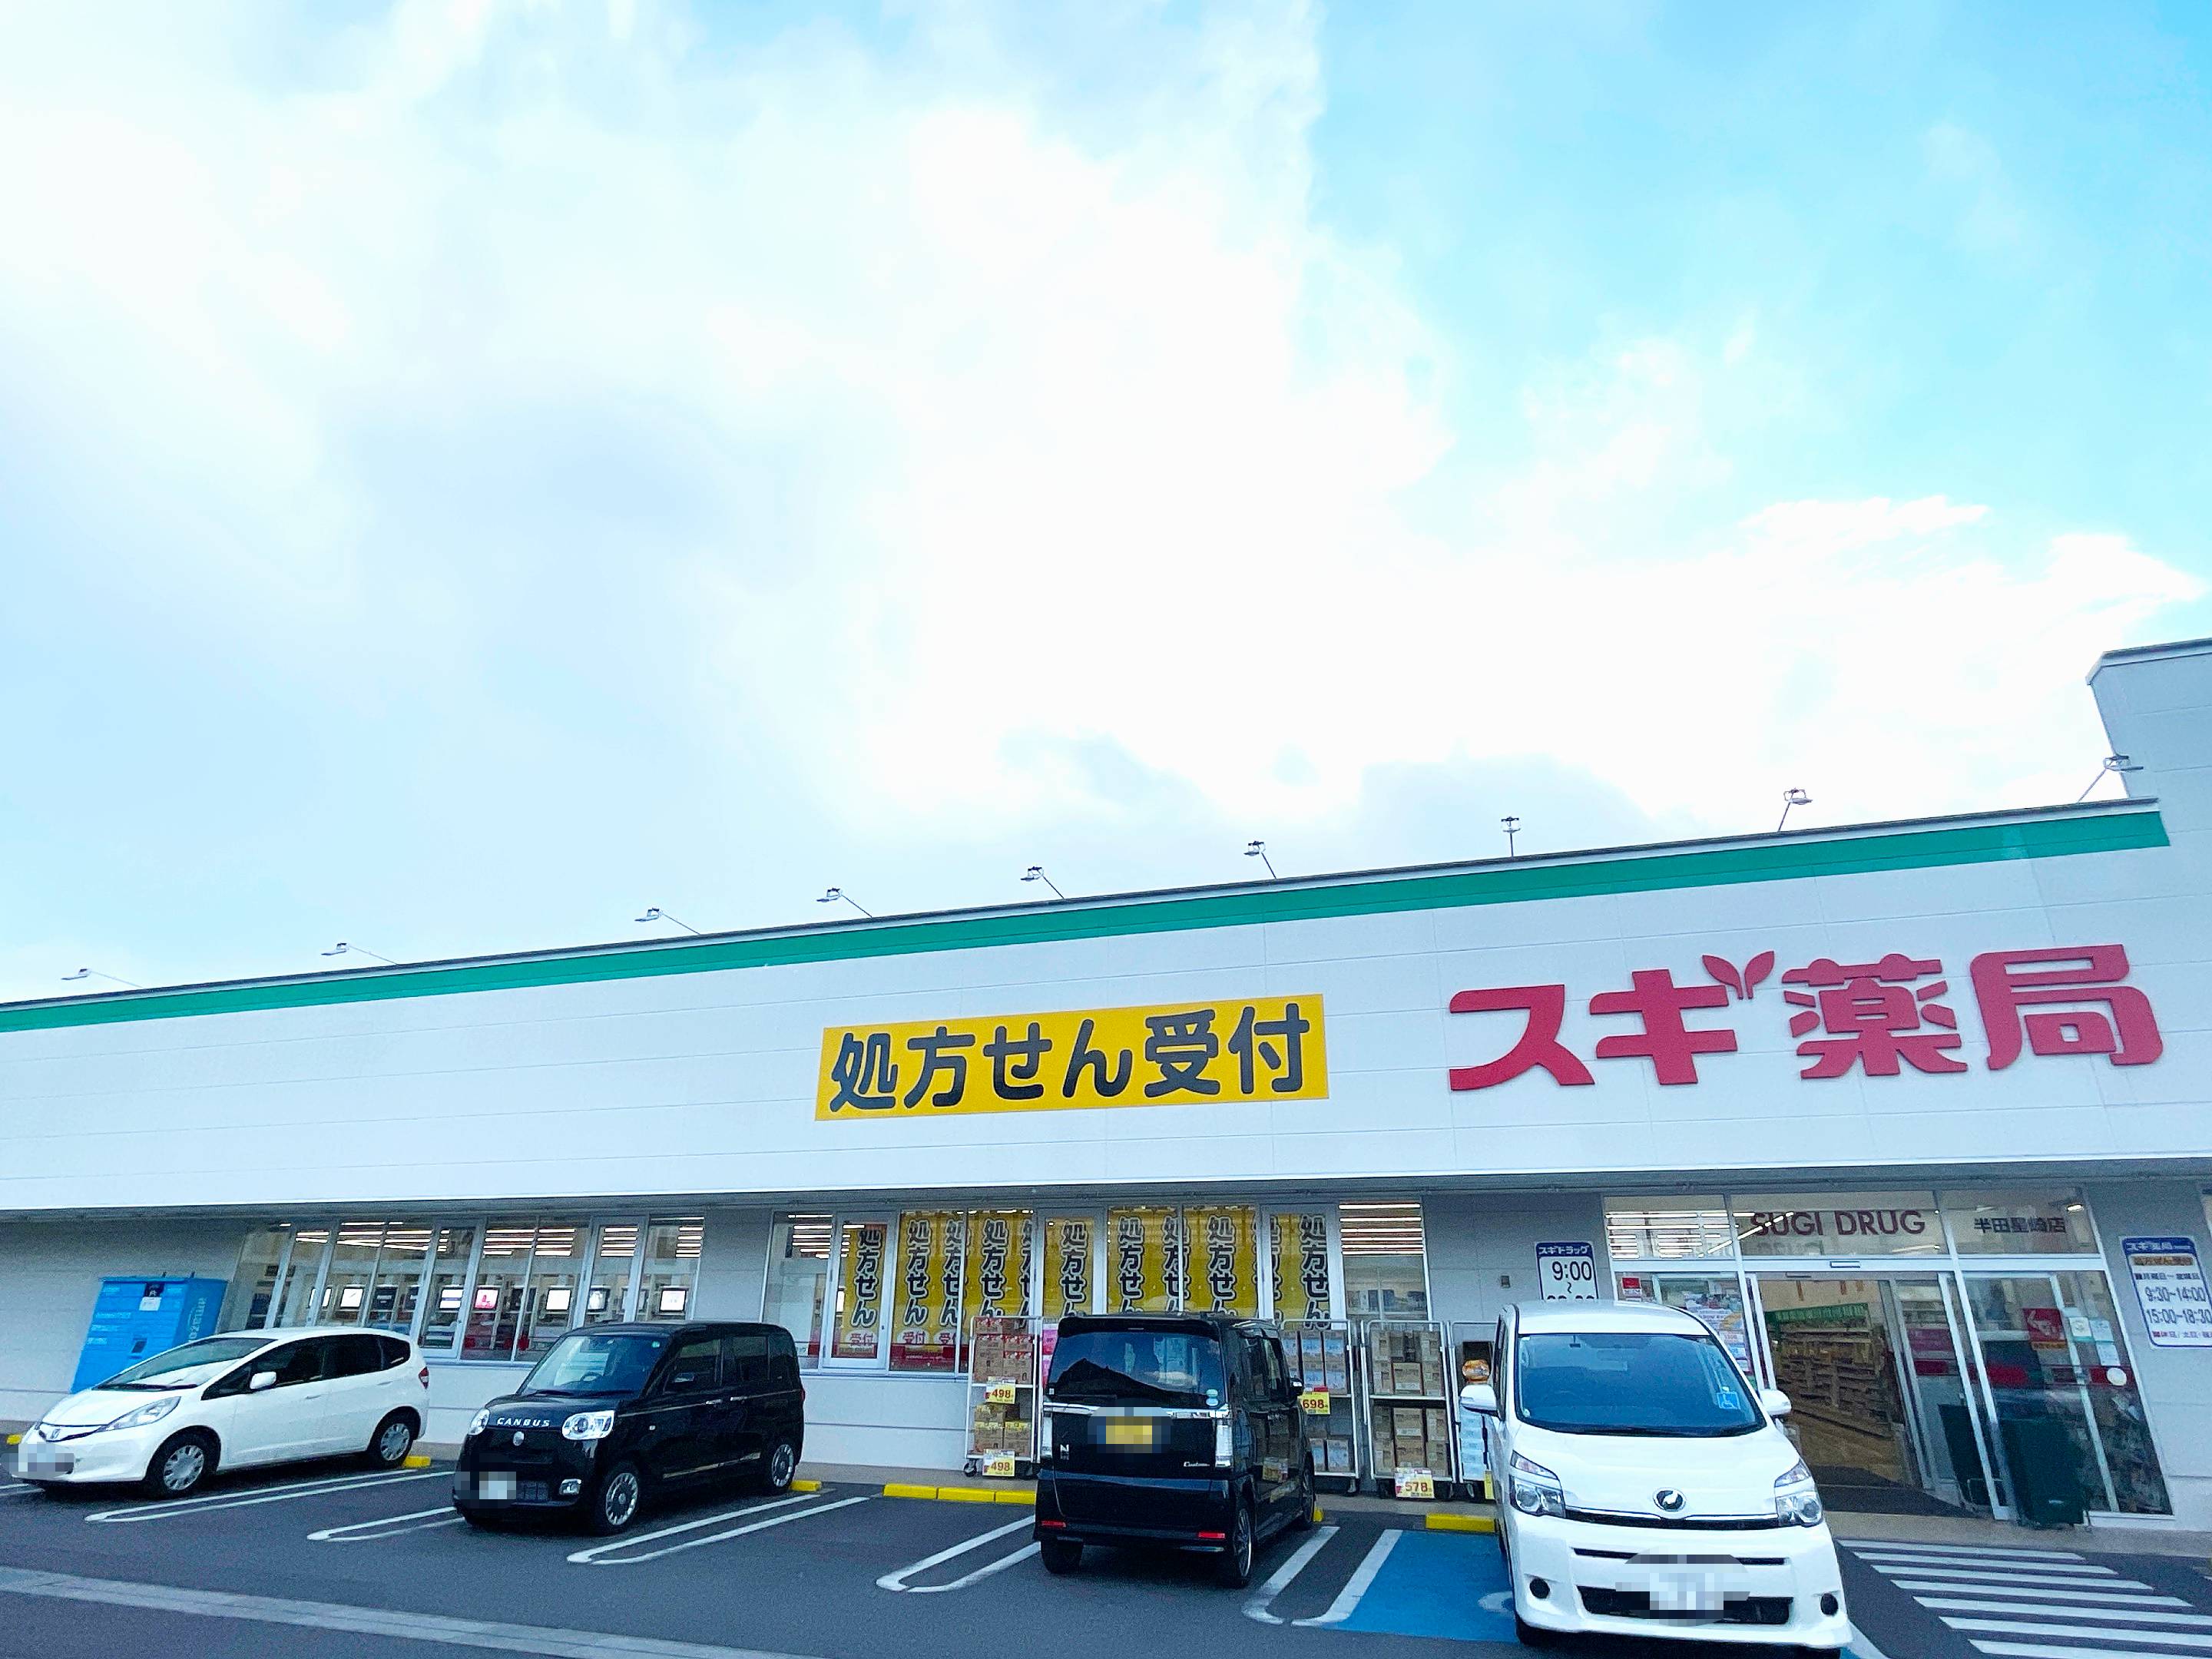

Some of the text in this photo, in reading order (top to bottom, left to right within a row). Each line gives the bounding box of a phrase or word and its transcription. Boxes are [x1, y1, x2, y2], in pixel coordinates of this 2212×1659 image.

[1449, 944, 2164, 1091] スギ薬局
[830, 1002, 1310, 1113] 処方せん受付
[1750, 1210, 1926, 1236] SUGI DRUG
[1538, 1246, 1590, 1255] スギドラッグ
[904, 1219, 930, 1324] 処方せん
[1552, 1261, 1592, 1281] 9:00
[902, 1331, 926, 1344] 受付
[992, 1389, 1011, 1398] 498
[1302, 1399, 1325, 1409] 698
[496, 1417, 550, 1427] CANBUS
[991, 1462, 1011, 1472] 498
[1405, 1482, 1428, 1492] 578
